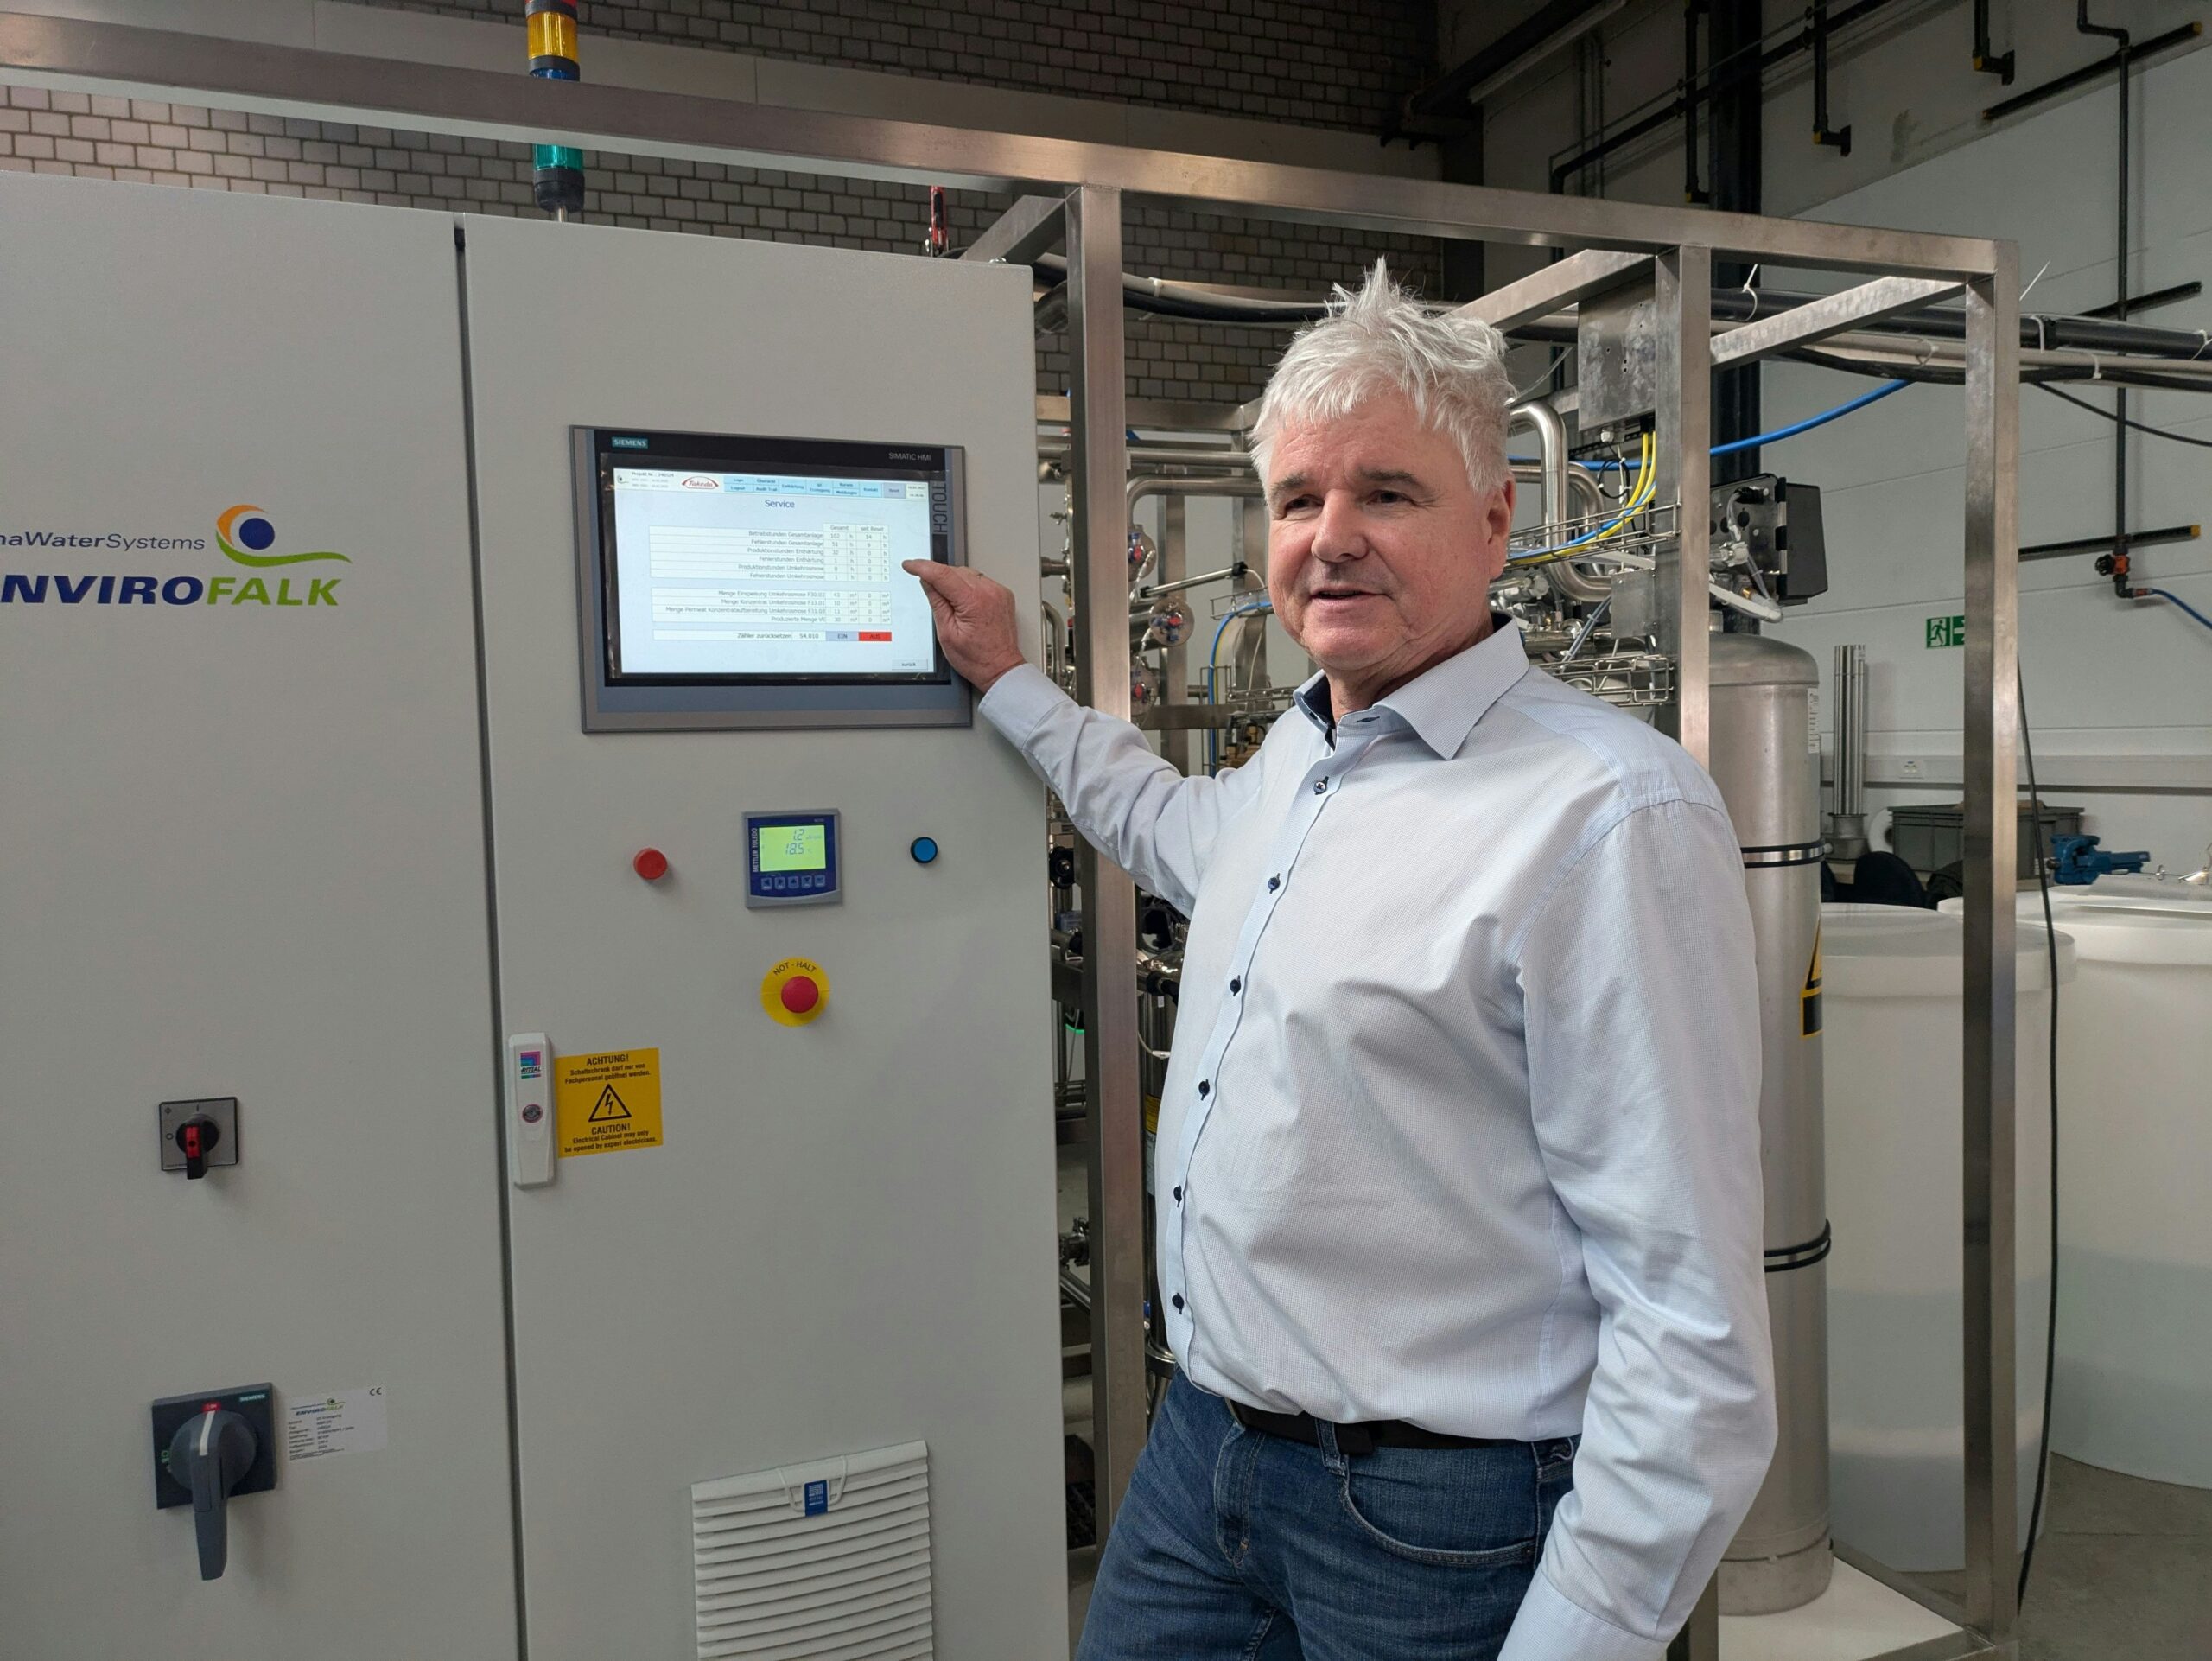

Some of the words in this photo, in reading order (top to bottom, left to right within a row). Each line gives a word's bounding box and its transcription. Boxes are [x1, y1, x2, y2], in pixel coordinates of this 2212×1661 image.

[764, 500, 795, 508] Service
[931, 484, 948, 533] TOUCH
[772, 961, 790, 975] NOT
[797, 961, 817, 973] HALT
[587, 1054, 629, 1066] ACHTUNG!
[565, 1075, 603, 1084] Fachpersonal
[605, 1072, 627, 1080] geöffnet
[591, 1123, 631, 1135] CAUTION!
